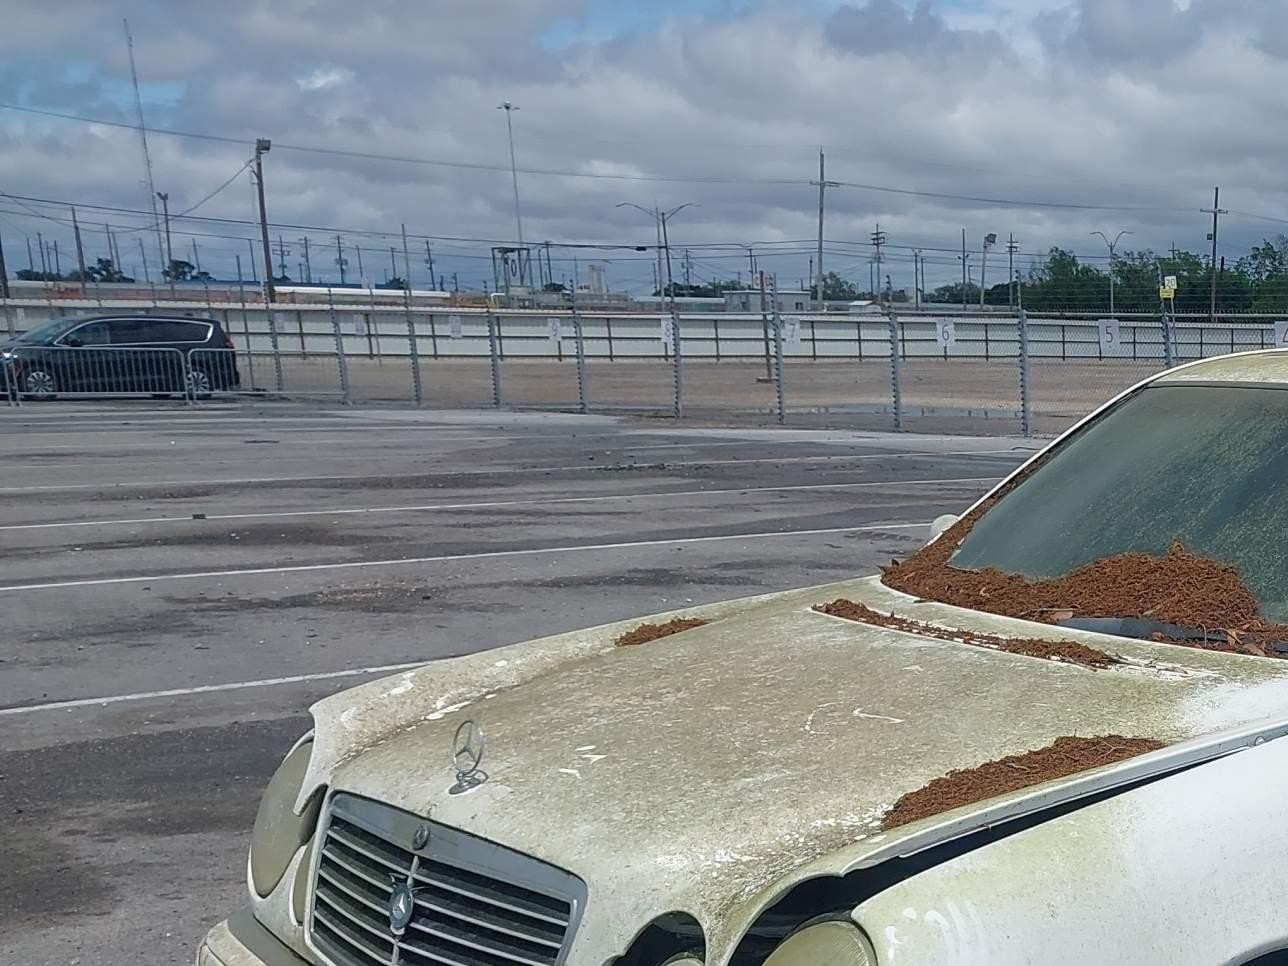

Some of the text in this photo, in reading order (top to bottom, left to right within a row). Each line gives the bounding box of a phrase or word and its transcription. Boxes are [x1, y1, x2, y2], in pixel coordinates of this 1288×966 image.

[665, 323, 671, 337] 8
[787, 324, 796, 339] 7
[942, 325, 950, 341] 6
[1105, 326, 1113, 343] 5
